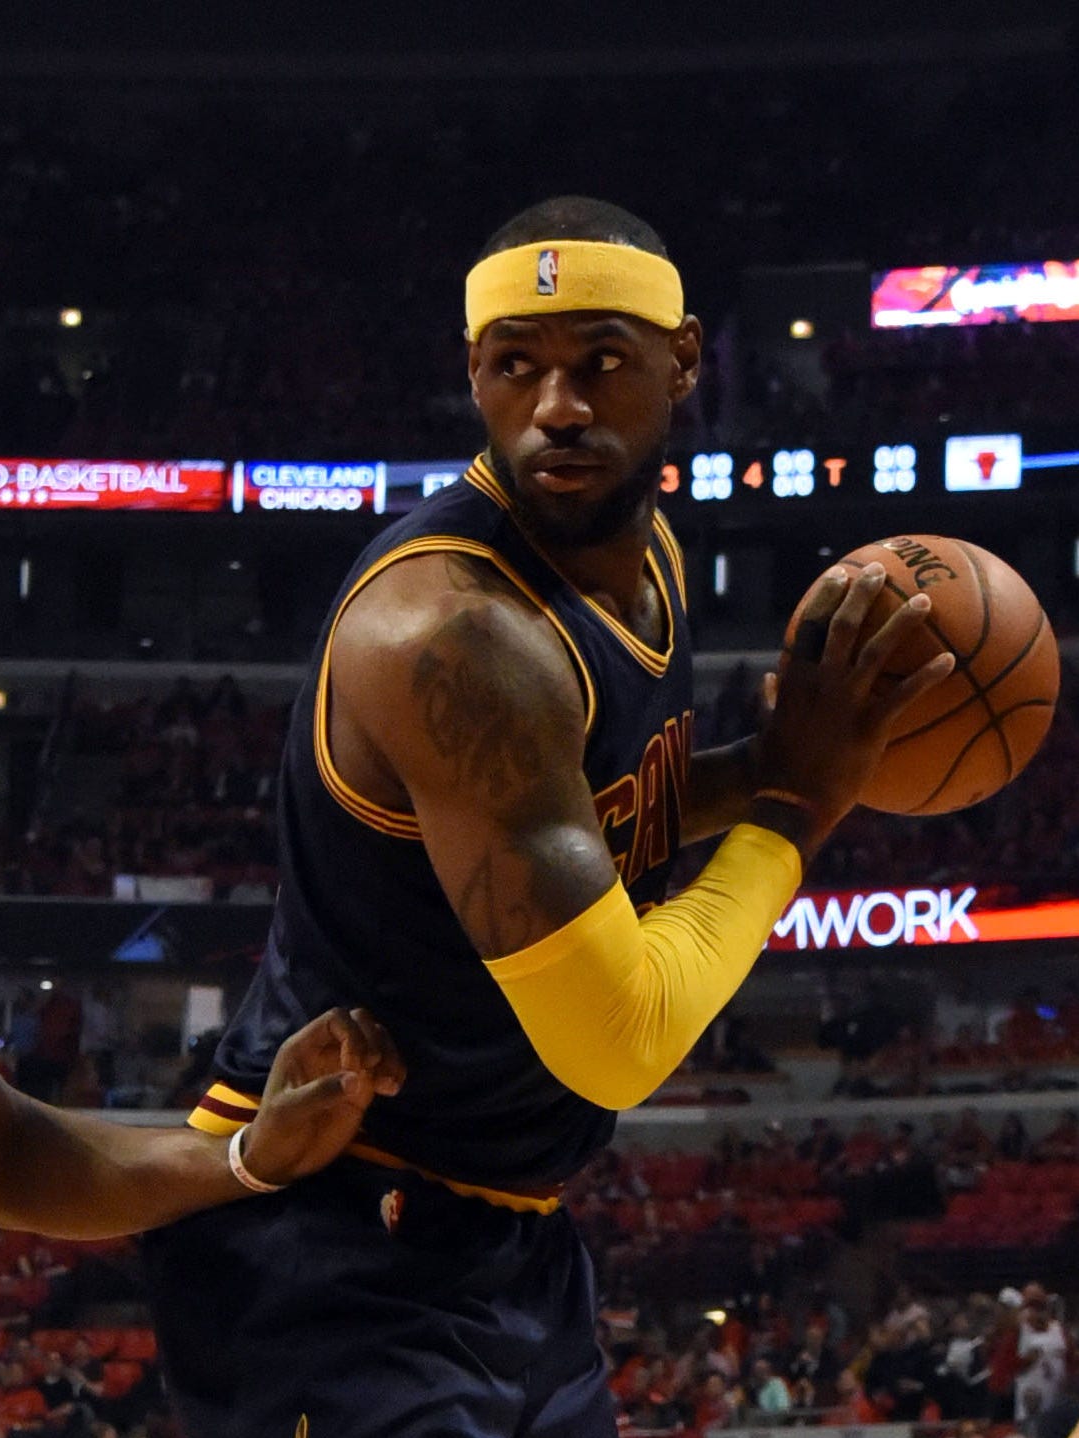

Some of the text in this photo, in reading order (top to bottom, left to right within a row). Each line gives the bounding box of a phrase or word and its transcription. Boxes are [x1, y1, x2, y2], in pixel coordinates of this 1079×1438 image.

[16, 463, 188, 493] BASKETBALL
[252, 465, 375, 488] CLEVELAND
[660, 465, 680, 493] 3
[743, 462, 763, 488] 4
[824, 458, 846, 487] T
[259, 487, 363, 511] CHICAGO
[763, 887, 980, 950] MWORK
